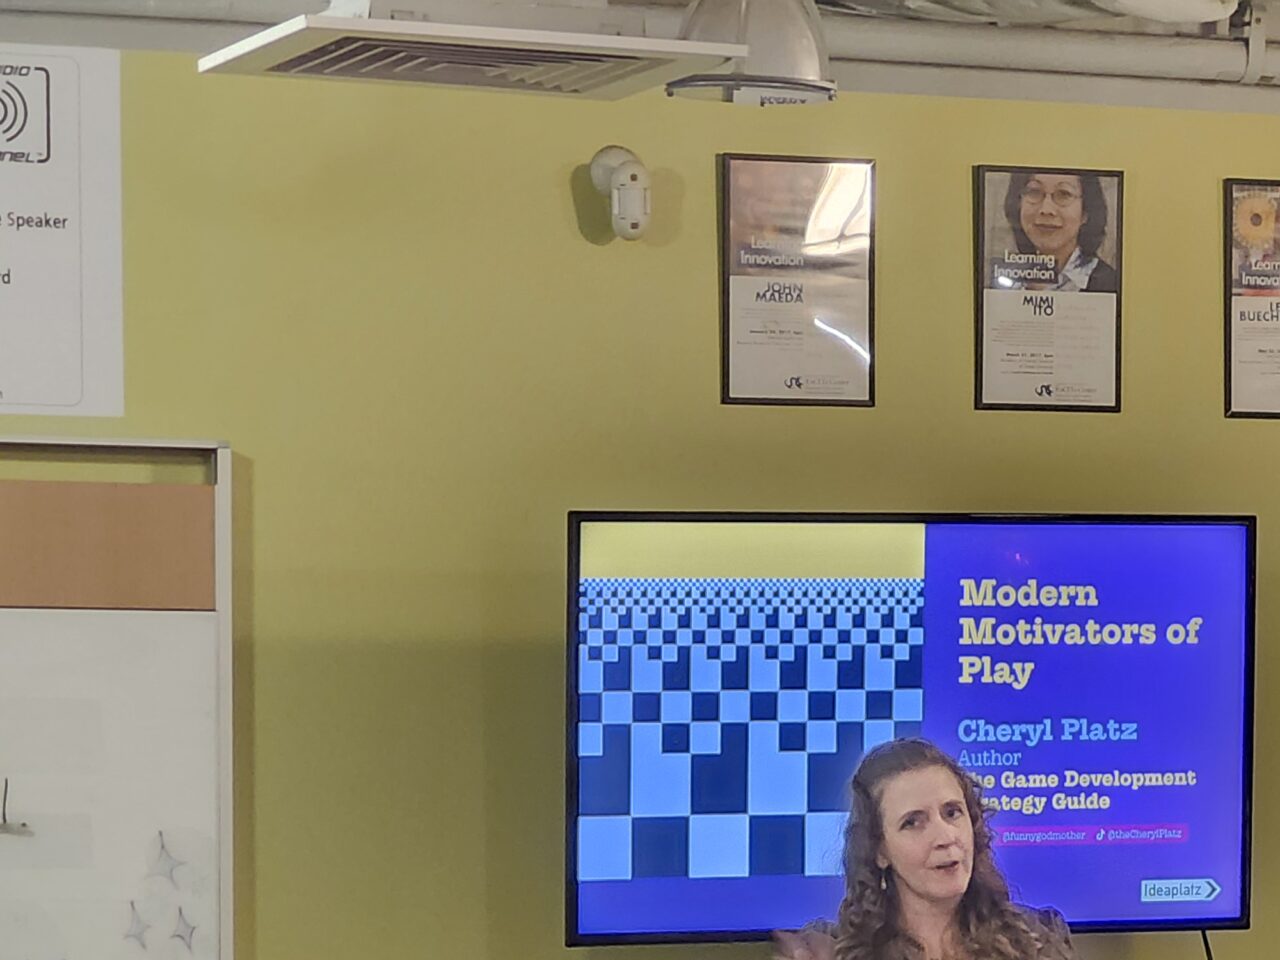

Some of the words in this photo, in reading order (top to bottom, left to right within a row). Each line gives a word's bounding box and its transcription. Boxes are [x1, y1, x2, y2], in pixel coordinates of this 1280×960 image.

[0, 65, 30, 76] DIO
[7, 212, 69, 230] Speaker
[740, 249, 804, 266] Innovation
[1004, 249, 1055, 268] Learning
[994, 264, 1055, 279] Innovation
[764, 282, 803, 293] JOHN
[755, 292, 804, 303] MAEDA
[1022, 296, 1054, 306] MIMI
[1033, 305, 1054, 316] ITO
[959, 578, 1099, 607] Modern
[958, 617, 1157, 646] Motivators
[1166, 616, 1203, 645] of
[958, 656, 1035, 689] Play
[957, 719, 1053, 747] Cheryl
[1061, 718, 1138, 741] Platz
[958, 749, 1022, 766] Author
[1001, 771, 1059, 788] Game
[1064, 770, 1197, 789] Development
[1052, 793, 1111, 810] Guide
[1144, 883, 1202, 900] Ideaplatz
